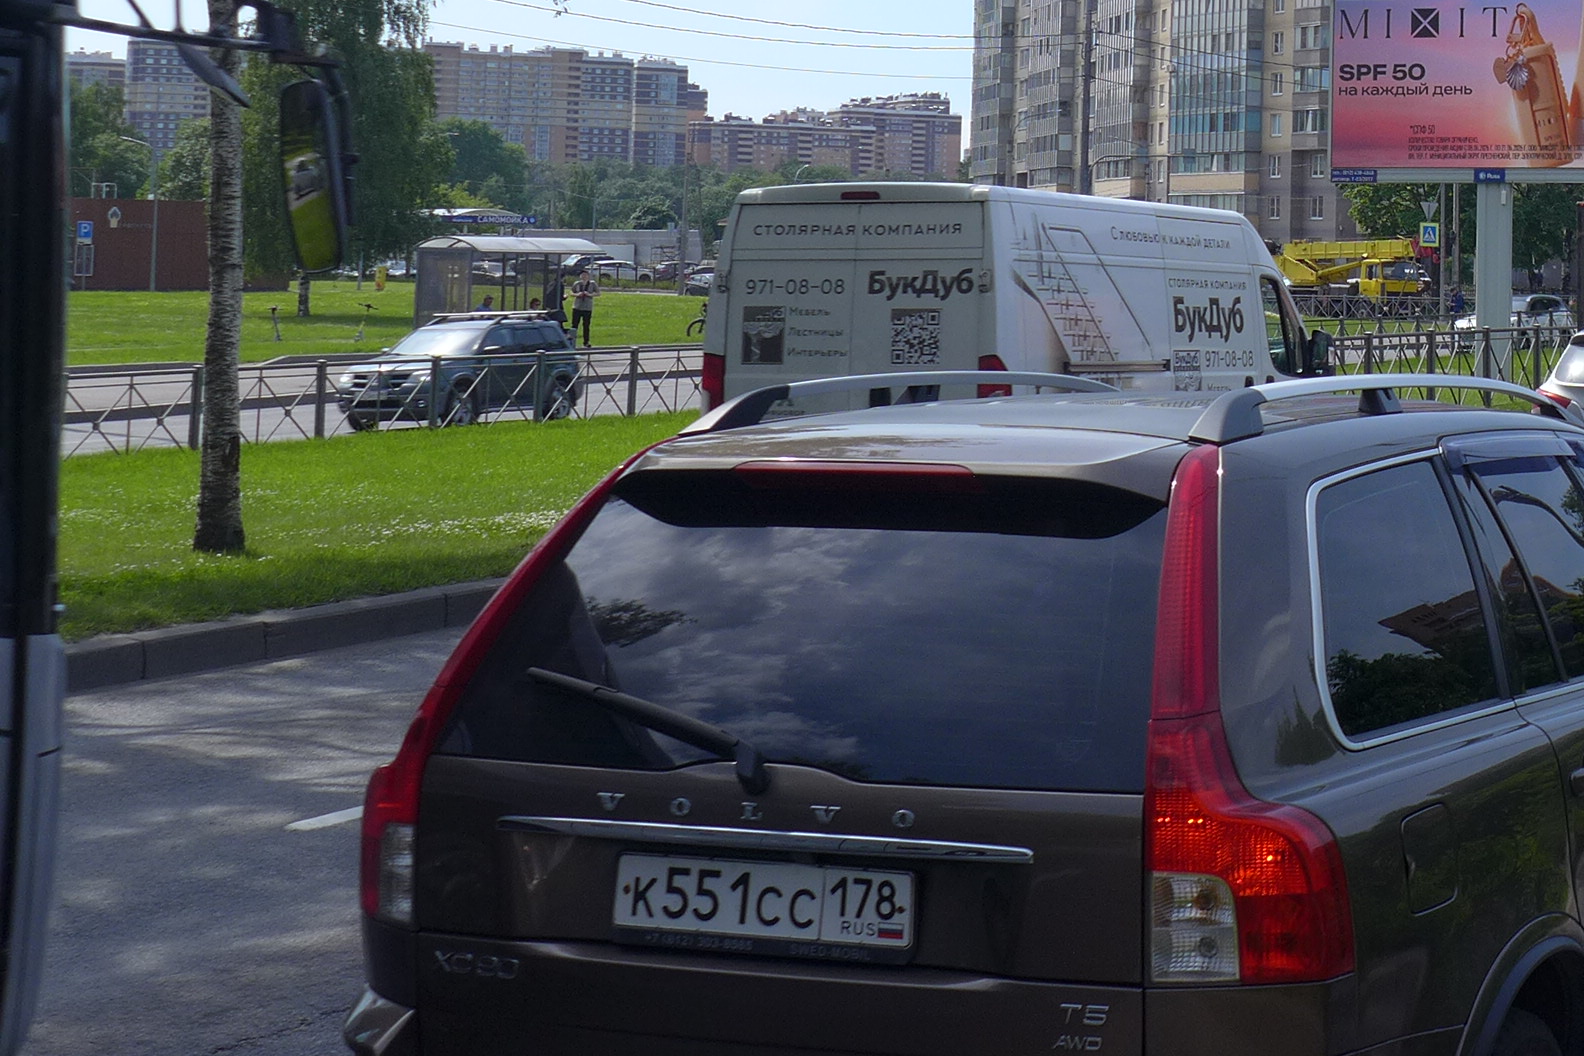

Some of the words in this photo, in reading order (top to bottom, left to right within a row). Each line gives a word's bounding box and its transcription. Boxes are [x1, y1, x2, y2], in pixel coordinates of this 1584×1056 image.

[1338, 64, 1387, 82] SPF
[1392, 63, 1426, 81] 50
[1338, 86, 1358, 96] на
[1361, 83, 1429, 98] каждый
[1432, 85, 1473, 97] день
[753, 224, 856, 236] СТОЛЯРНАЯ
[862, 223, 962, 236] КОМПАНИЯ
[1110, 226, 1118, 240] С
[745, 279, 845, 295] 971-08-08
[868, 268, 974, 301] БукДуб
[1168, 277, 1208, 289] СТОЛЯРНАЯ
[1210, 280, 1247, 290] КОМПАНИЯ
[1173, 296, 1244, 343] БукДуб
[1205, 350, 1254, 367] 971-08-08
[597, 792, 915, 828] VOLVO
[631, 866, 817, 929] К551СС
[830, 877, 896, 921] 178
[841, 920, 875, 936] RUS
[1060, 1003, 1109, 1025] T5
[1052, 1035, 1102, 1050] AWD
